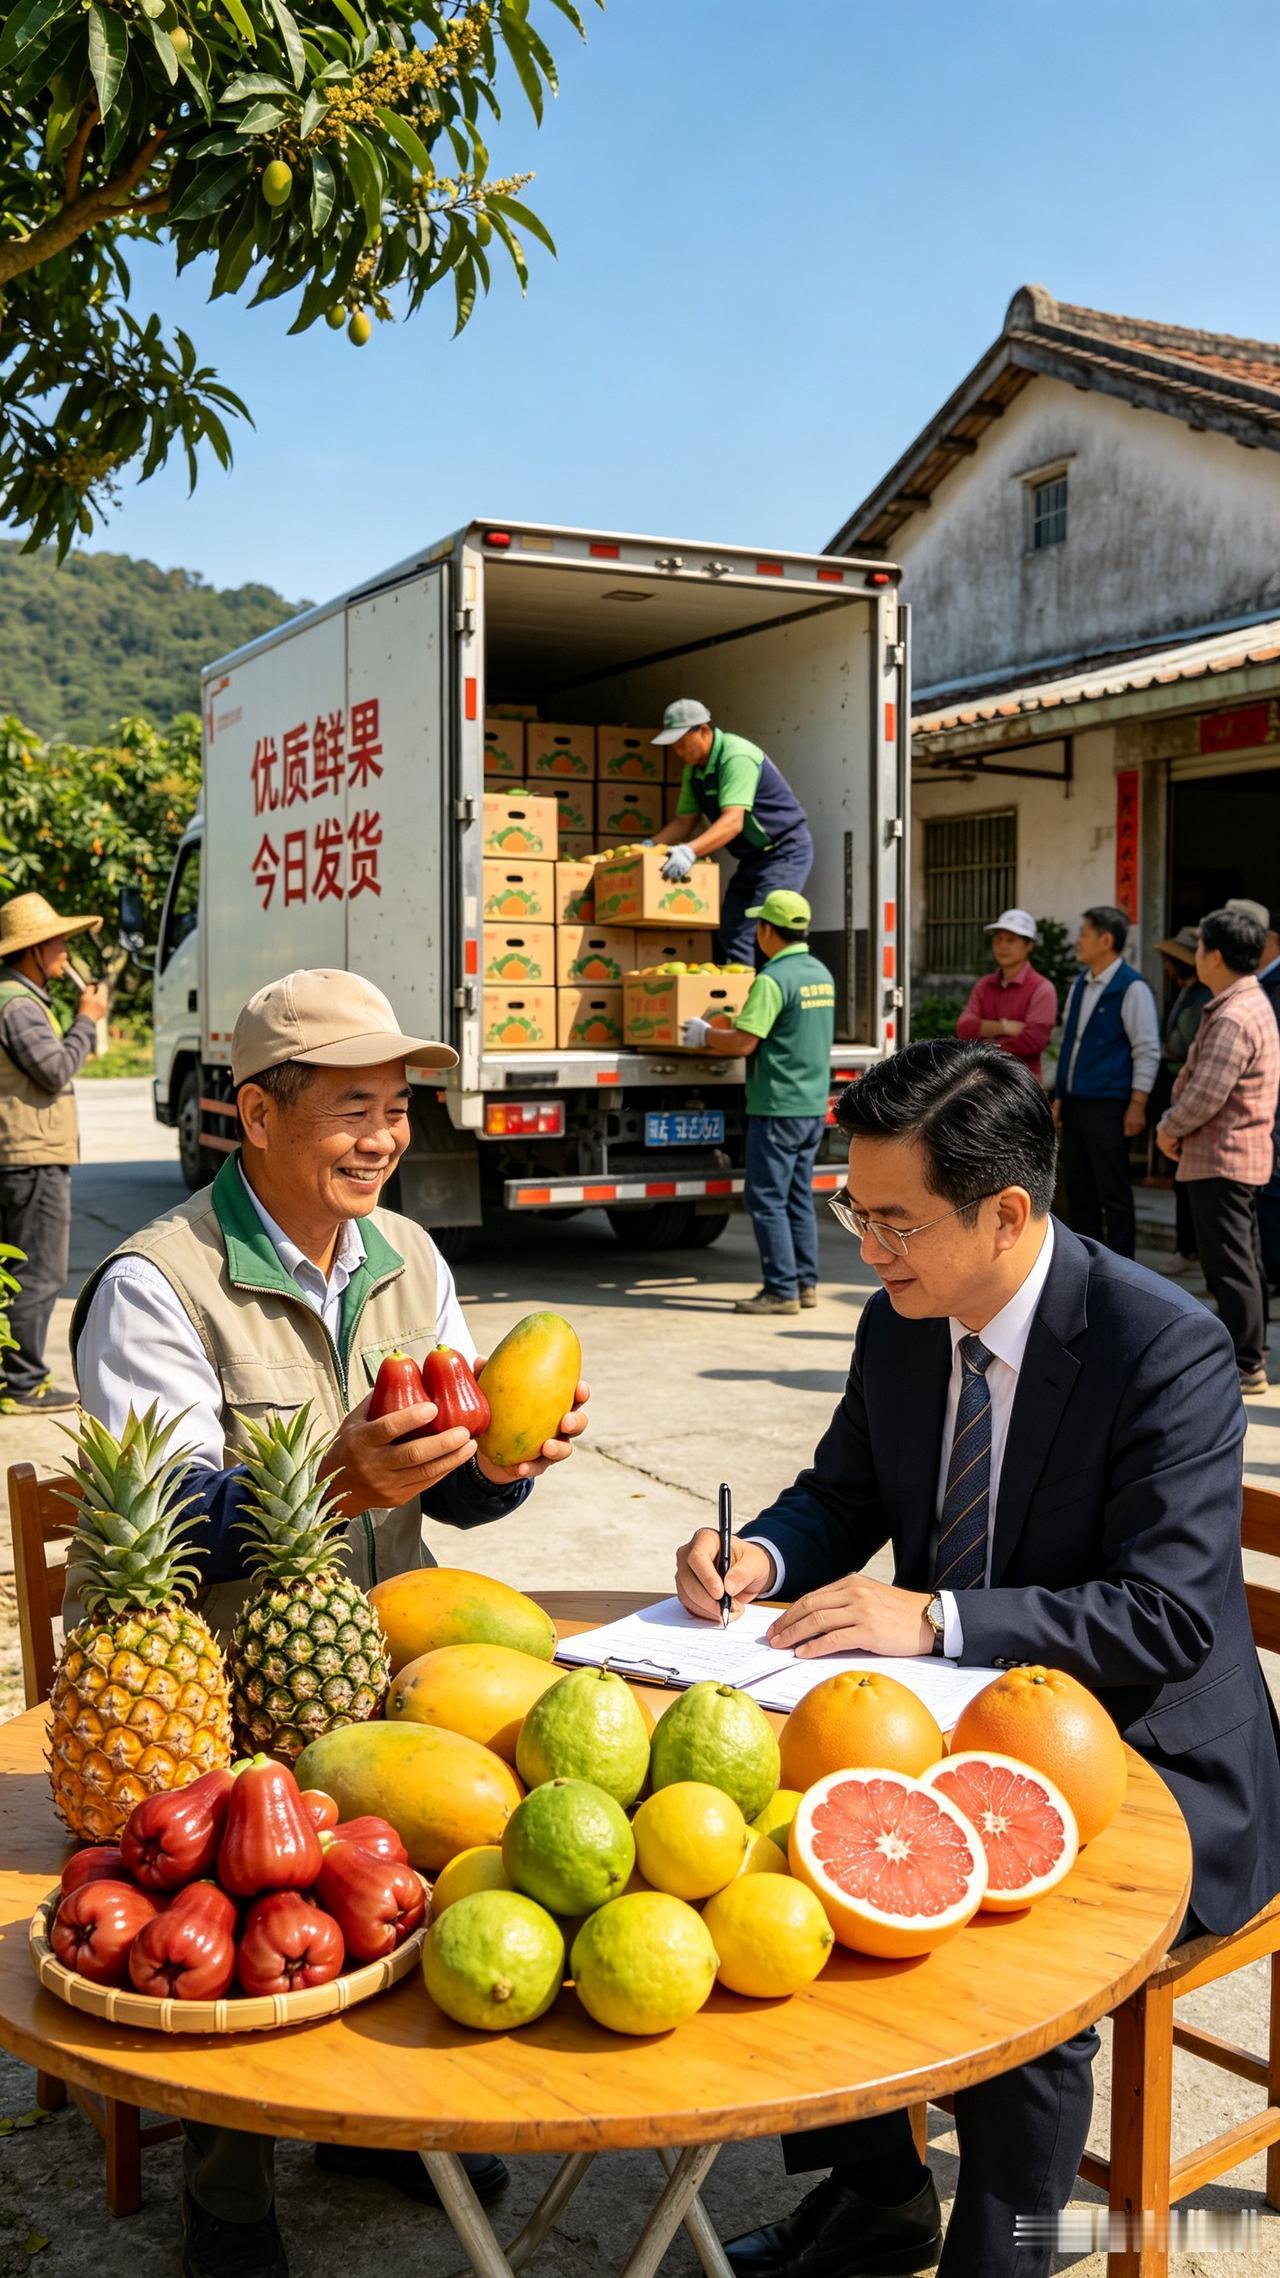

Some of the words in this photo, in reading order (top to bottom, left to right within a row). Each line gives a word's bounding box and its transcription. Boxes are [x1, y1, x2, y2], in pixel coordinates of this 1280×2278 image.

[251, 698, 384, 816] 优质鲜果
[252, 809, 383, 911] 今日发货
